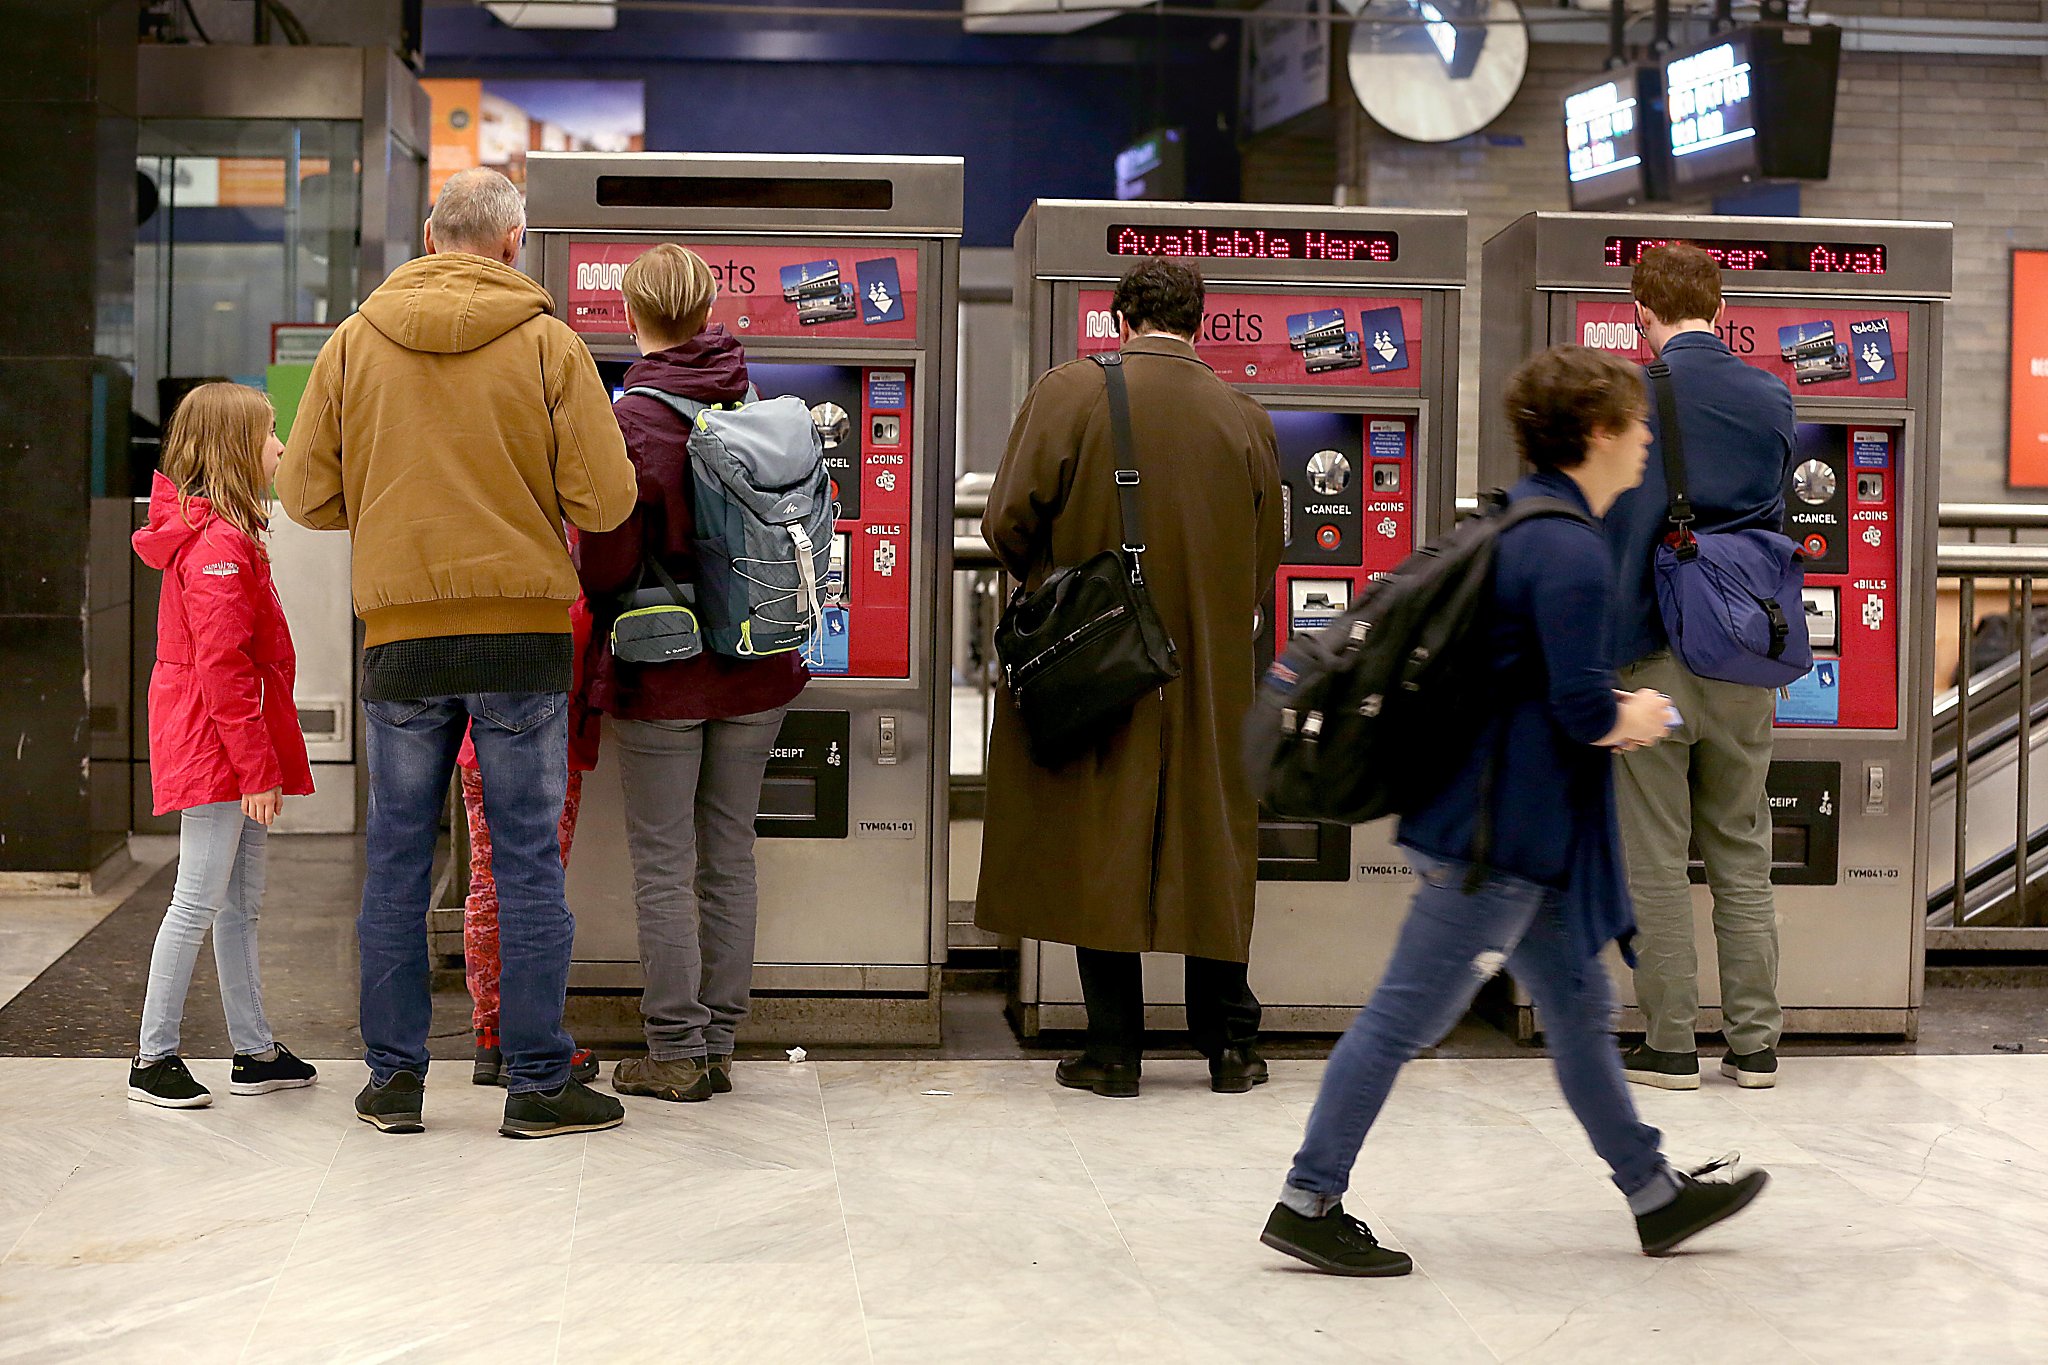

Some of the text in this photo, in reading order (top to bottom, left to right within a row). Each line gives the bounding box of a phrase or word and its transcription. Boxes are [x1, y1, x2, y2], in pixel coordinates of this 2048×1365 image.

[1118, 227, 1391, 262] Available Here
[576, 306, 609, 316] SFMTA
[822, 457, 850, 468] NCEL
[872, 454, 904, 465] COINS
[1311, 504, 1352, 515] CANCEL
[1374, 502, 1404, 512] COINS
[1798, 513, 1838, 524] CANCEL
[1858, 510, 1888, 520] COINS
[871, 525, 900, 535] BILLS
[1859, 579, 1887, 589] BILLS
[1768, 797, 1798, 808] CEIPT
[859, 822, 913, 832] TVM041-01
[1360, 866, 1413, 875] TVM041-02
[1848, 870, 1899, 878] TVM041-03
